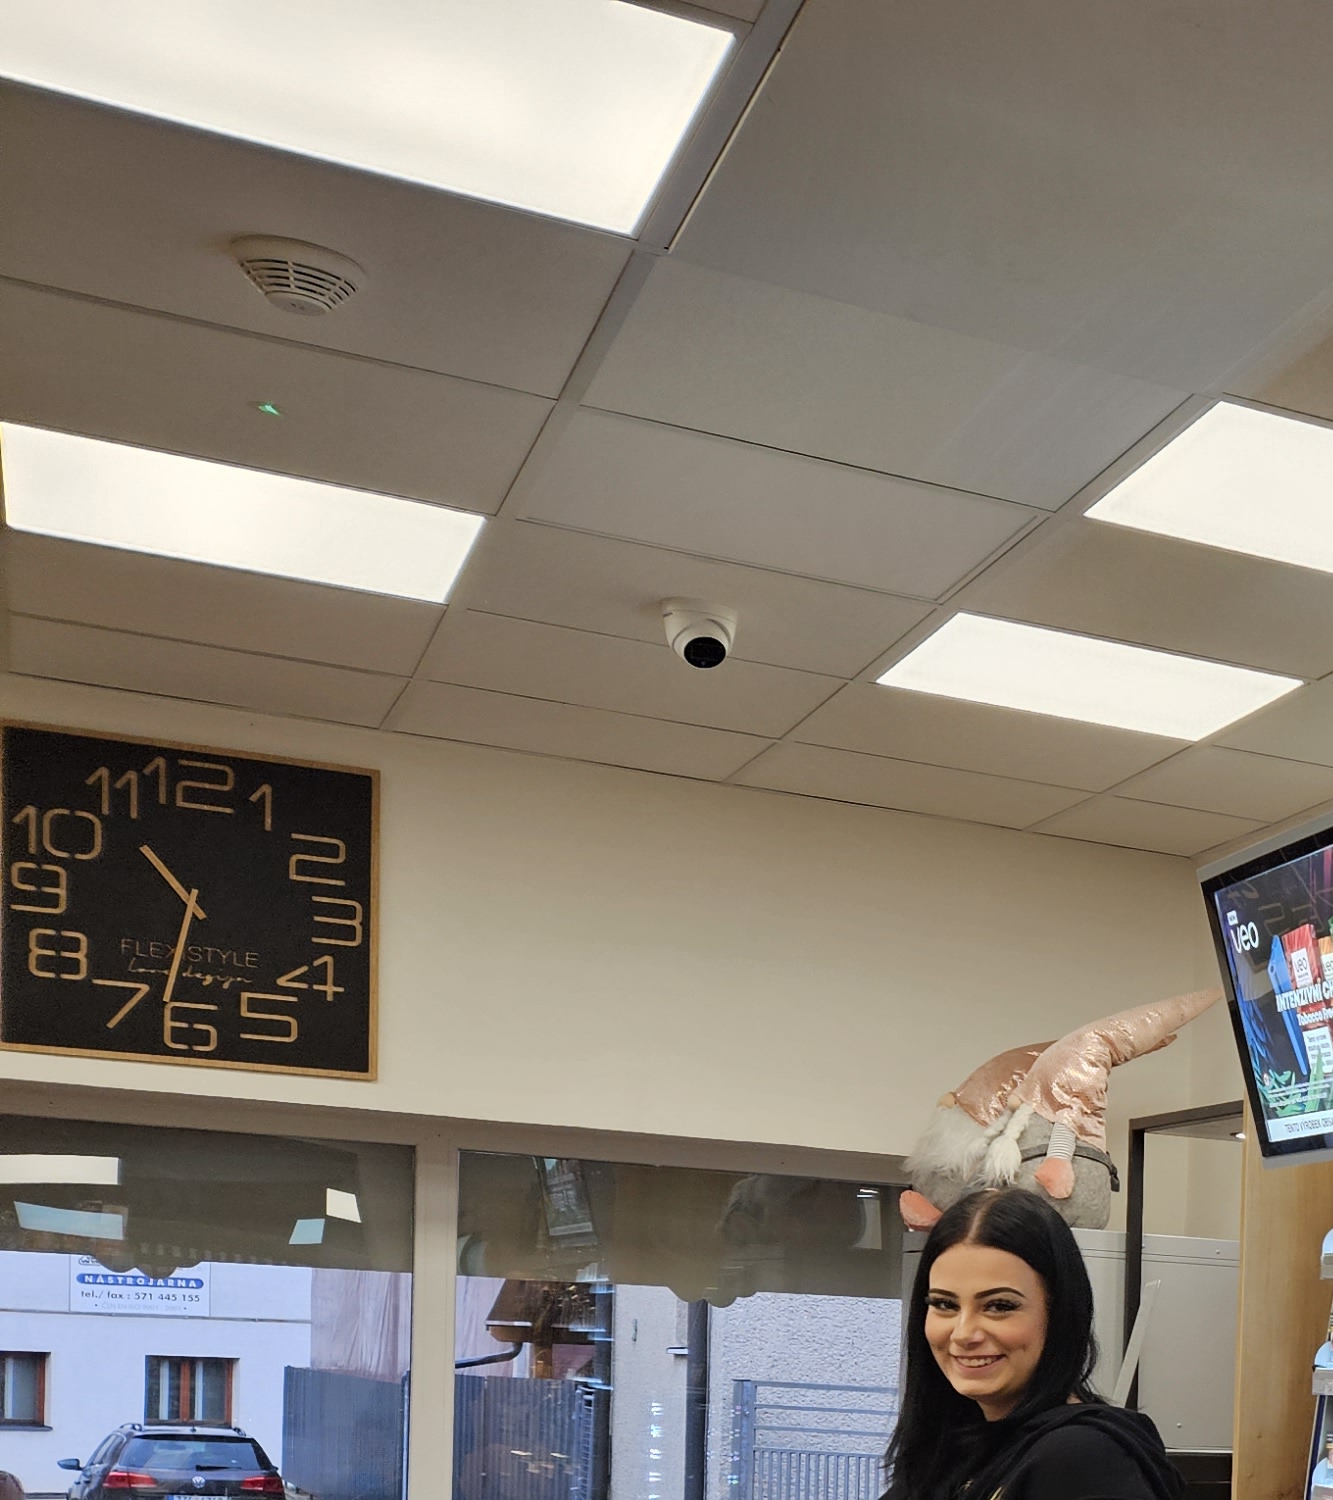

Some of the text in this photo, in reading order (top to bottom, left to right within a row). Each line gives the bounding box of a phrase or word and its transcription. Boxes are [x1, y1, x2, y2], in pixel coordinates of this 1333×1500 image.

[143, 756, 235, 813] 12
[248, 783, 273, 831] 1
[11, 804, 103, 860] 10
[288, 832, 347, 886] 2
[10, 861, 68, 914] 9
[311, 895, 363, 947] 3
[1230, 921, 1260, 954] veo
[28, 927, 88, 981] 8
[276, 955, 345, 1002] 4
[92, 978, 150, 1029] 7
[163, 1001, 219, 1051] 6
[240, 991, 299, 1043] 5
[134, 1292, 154, 1301] 571
[157, 1293, 178, 1302] 445
[181, 1294, 200, 1302] 155
